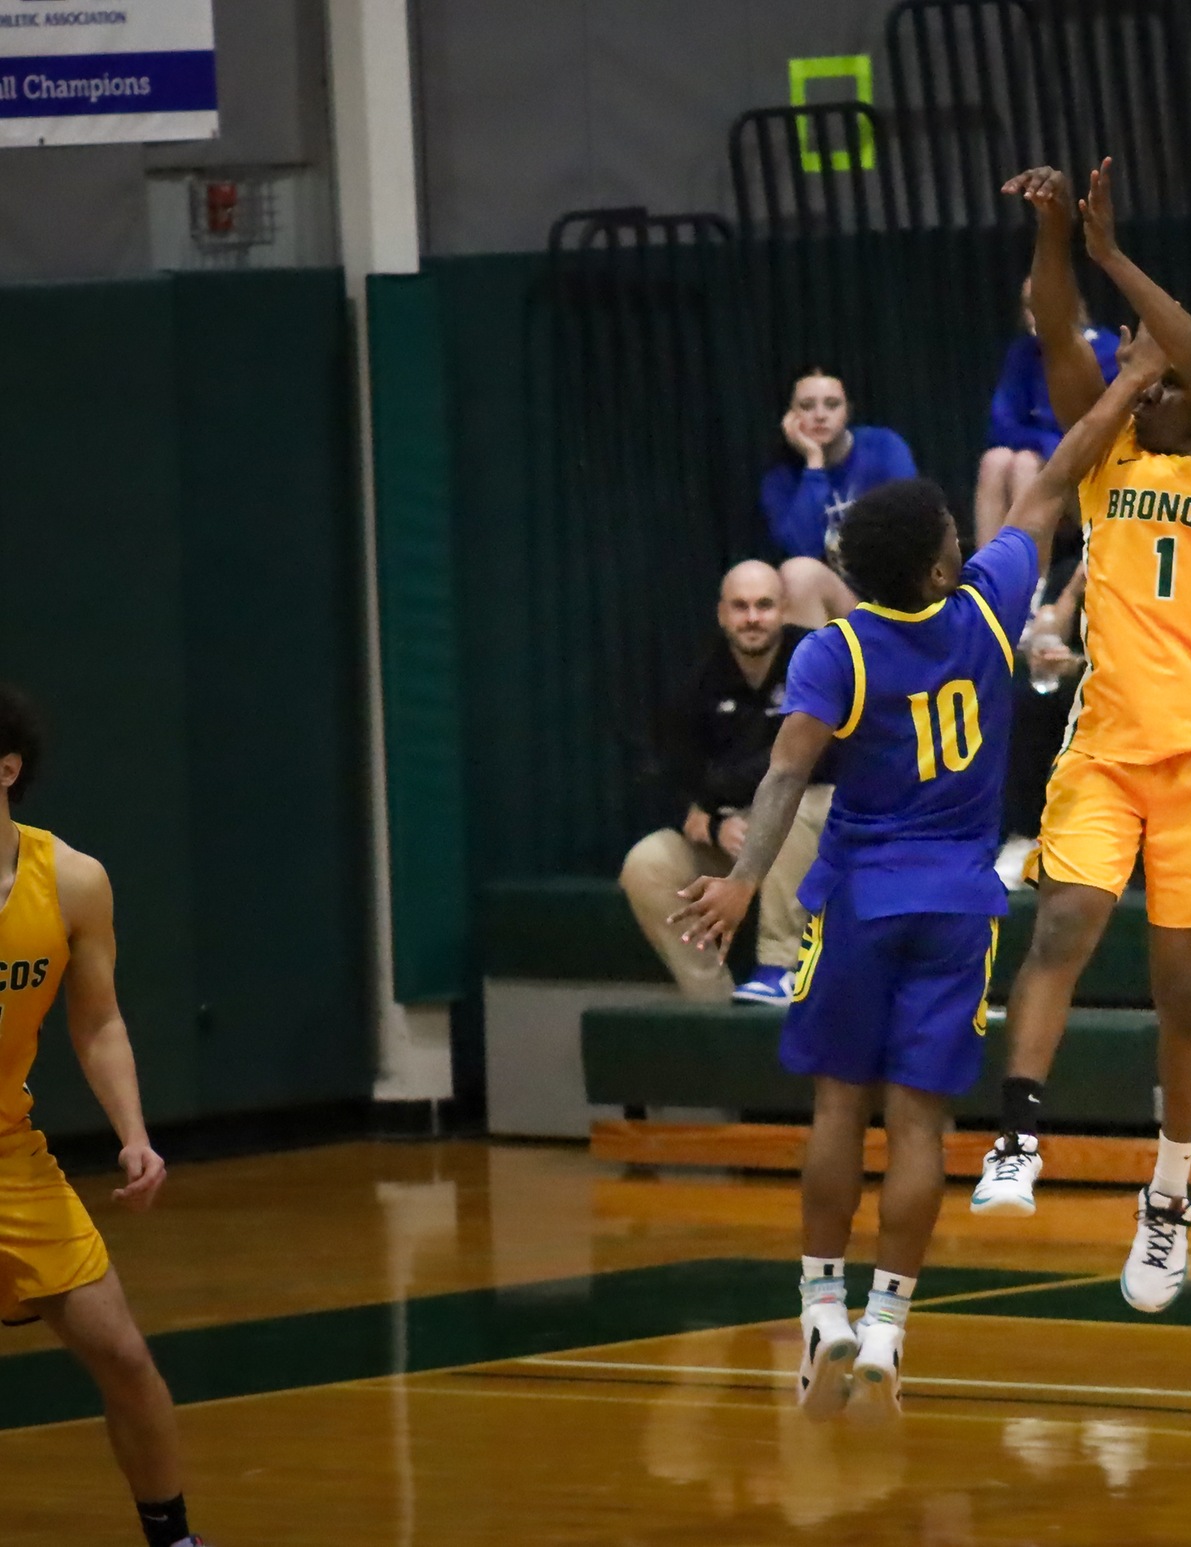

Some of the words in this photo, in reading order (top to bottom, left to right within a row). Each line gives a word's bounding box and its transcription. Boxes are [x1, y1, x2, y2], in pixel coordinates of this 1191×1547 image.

[44, 10, 127, 27] ASSOCIATION
[23, 73, 151, 103] Champions
[1153, 535, 1177, 600] 1
[907, 679, 983, 783] 10
